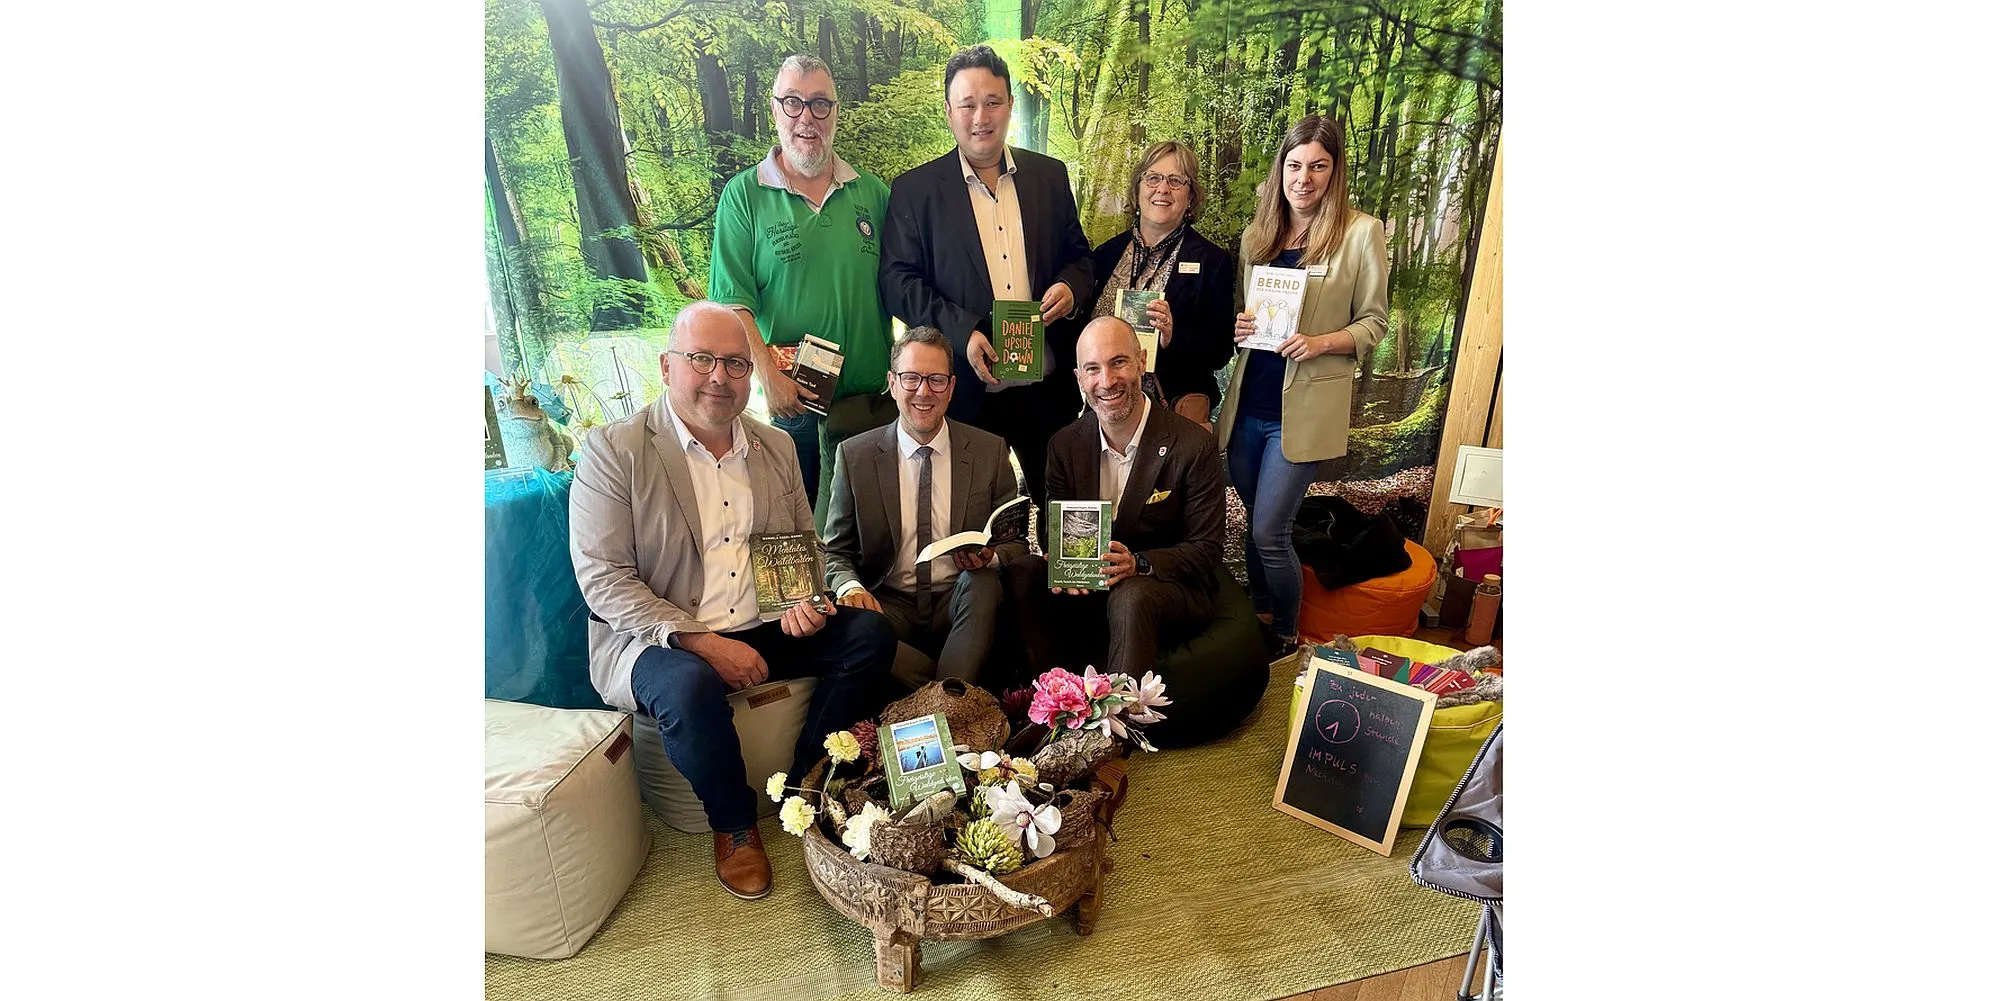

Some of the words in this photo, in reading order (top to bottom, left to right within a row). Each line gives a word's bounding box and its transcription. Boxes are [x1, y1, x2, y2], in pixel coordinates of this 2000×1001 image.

[1257, 277, 1300, 290] BERND
[1002, 320, 1035, 337] DANIEL
[1004, 337, 1033, 350] UPSIDE
[1003, 349, 1034, 365] DOWN
[1309, 747, 1357, 775] IMPULS
